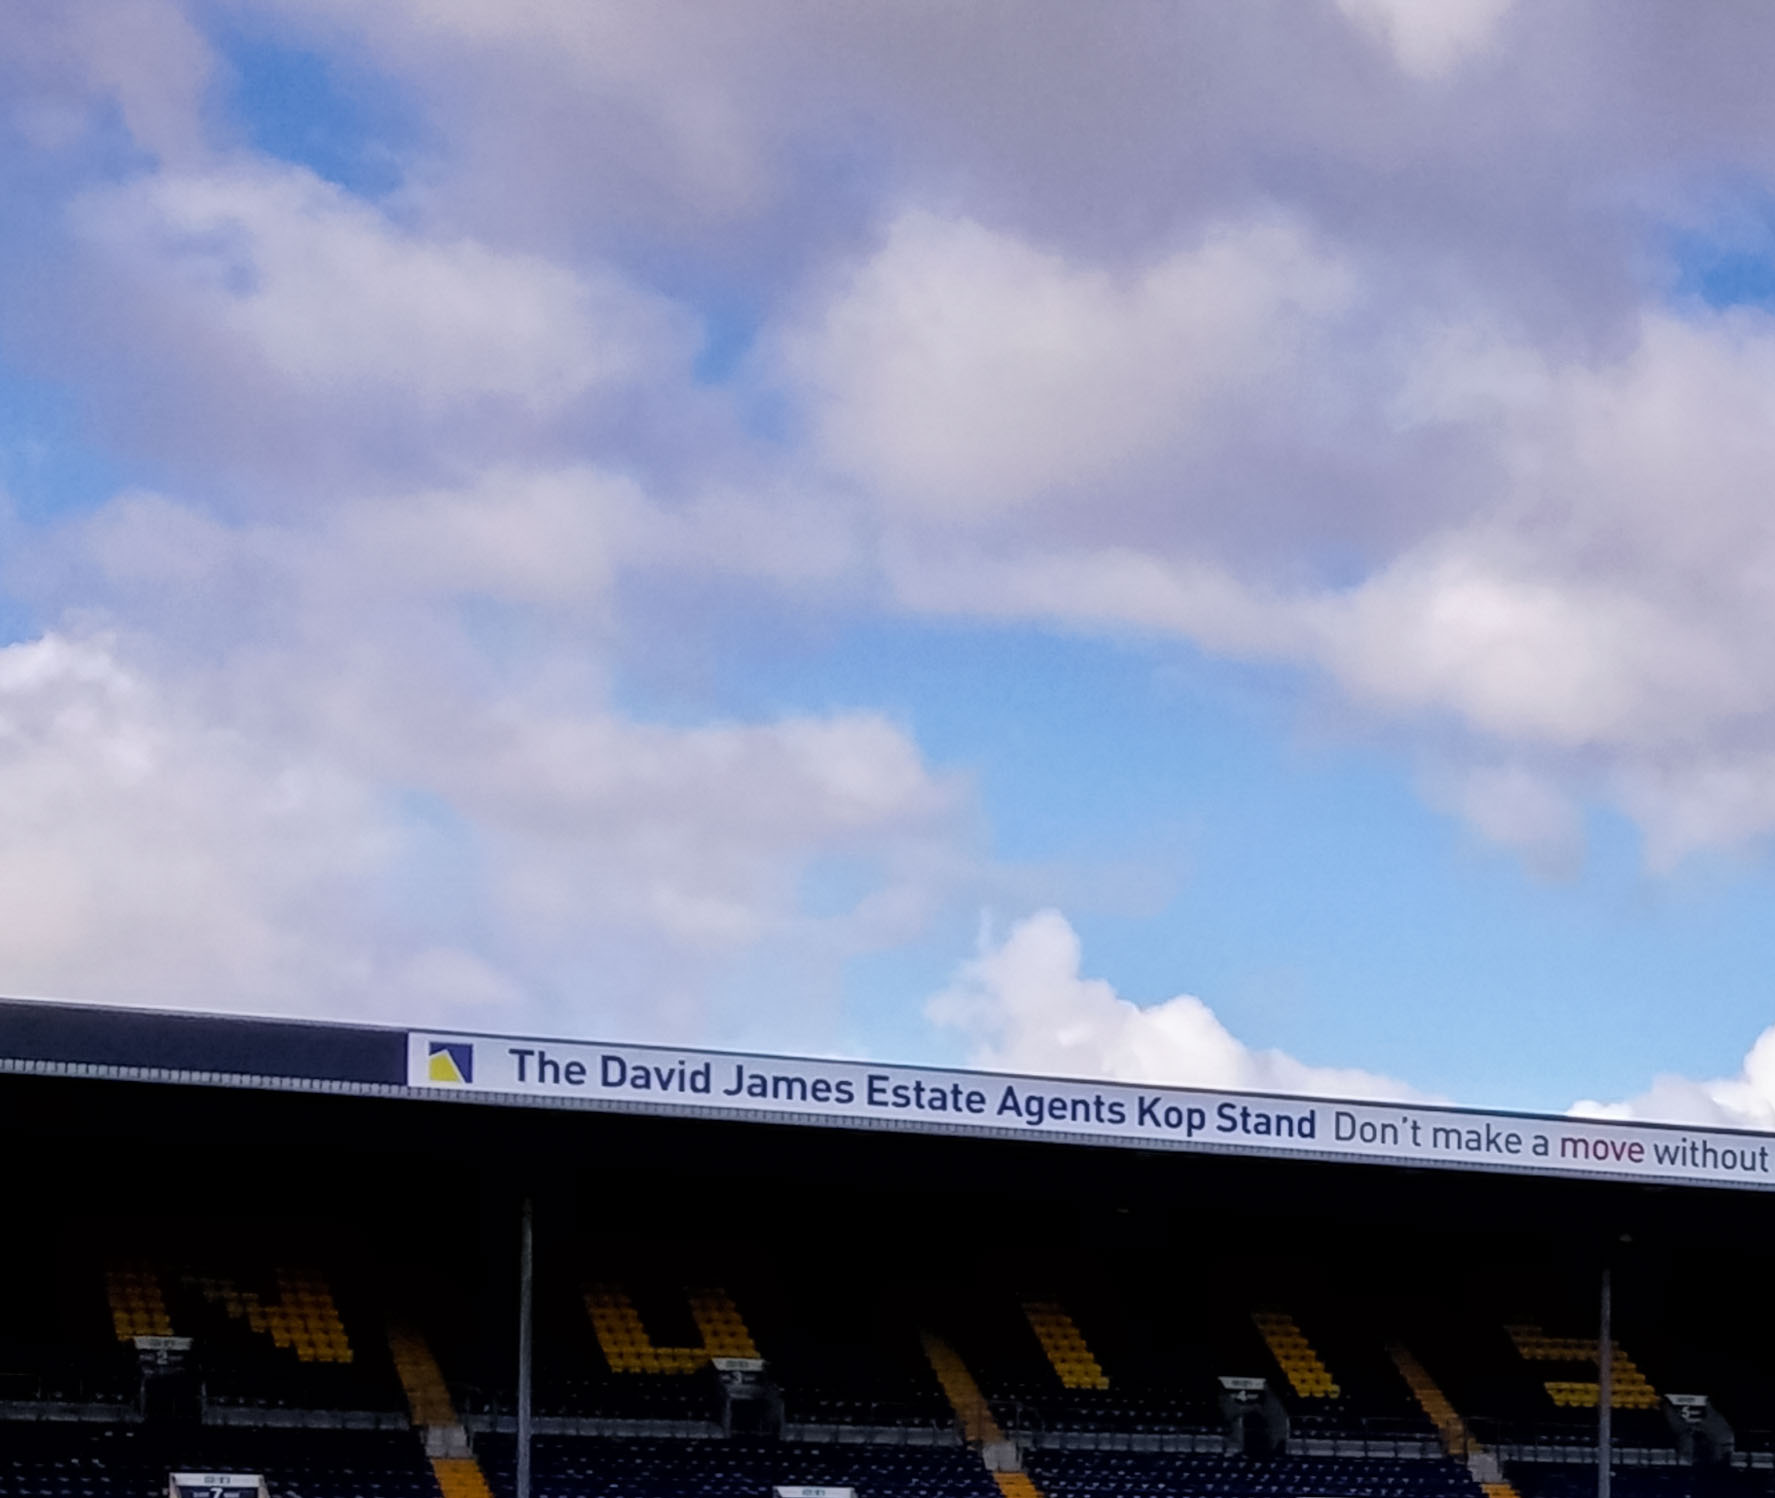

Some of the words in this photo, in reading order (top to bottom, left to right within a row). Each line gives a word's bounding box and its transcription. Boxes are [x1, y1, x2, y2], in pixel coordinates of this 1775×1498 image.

[509, 1048, 587, 1085] The
[601, 1056, 712, 1095] David
[724, 1064, 855, 1104] James
[867, 1074, 987, 1114] Estate
[997, 1083, 1127, 1127] Agents
[1137, 1096, 1206, 1138] Kop
[1216, 1102, 1317, 1140] Stand
[1334, 1111, 1422, 1148] Don't
[1432, 1119, 1522, 1155] make
[1531, 1134, 1549, 1157] a
[1560, 1137, 1645, 1164] move
[1654, 1136, 1770, 1173] without
